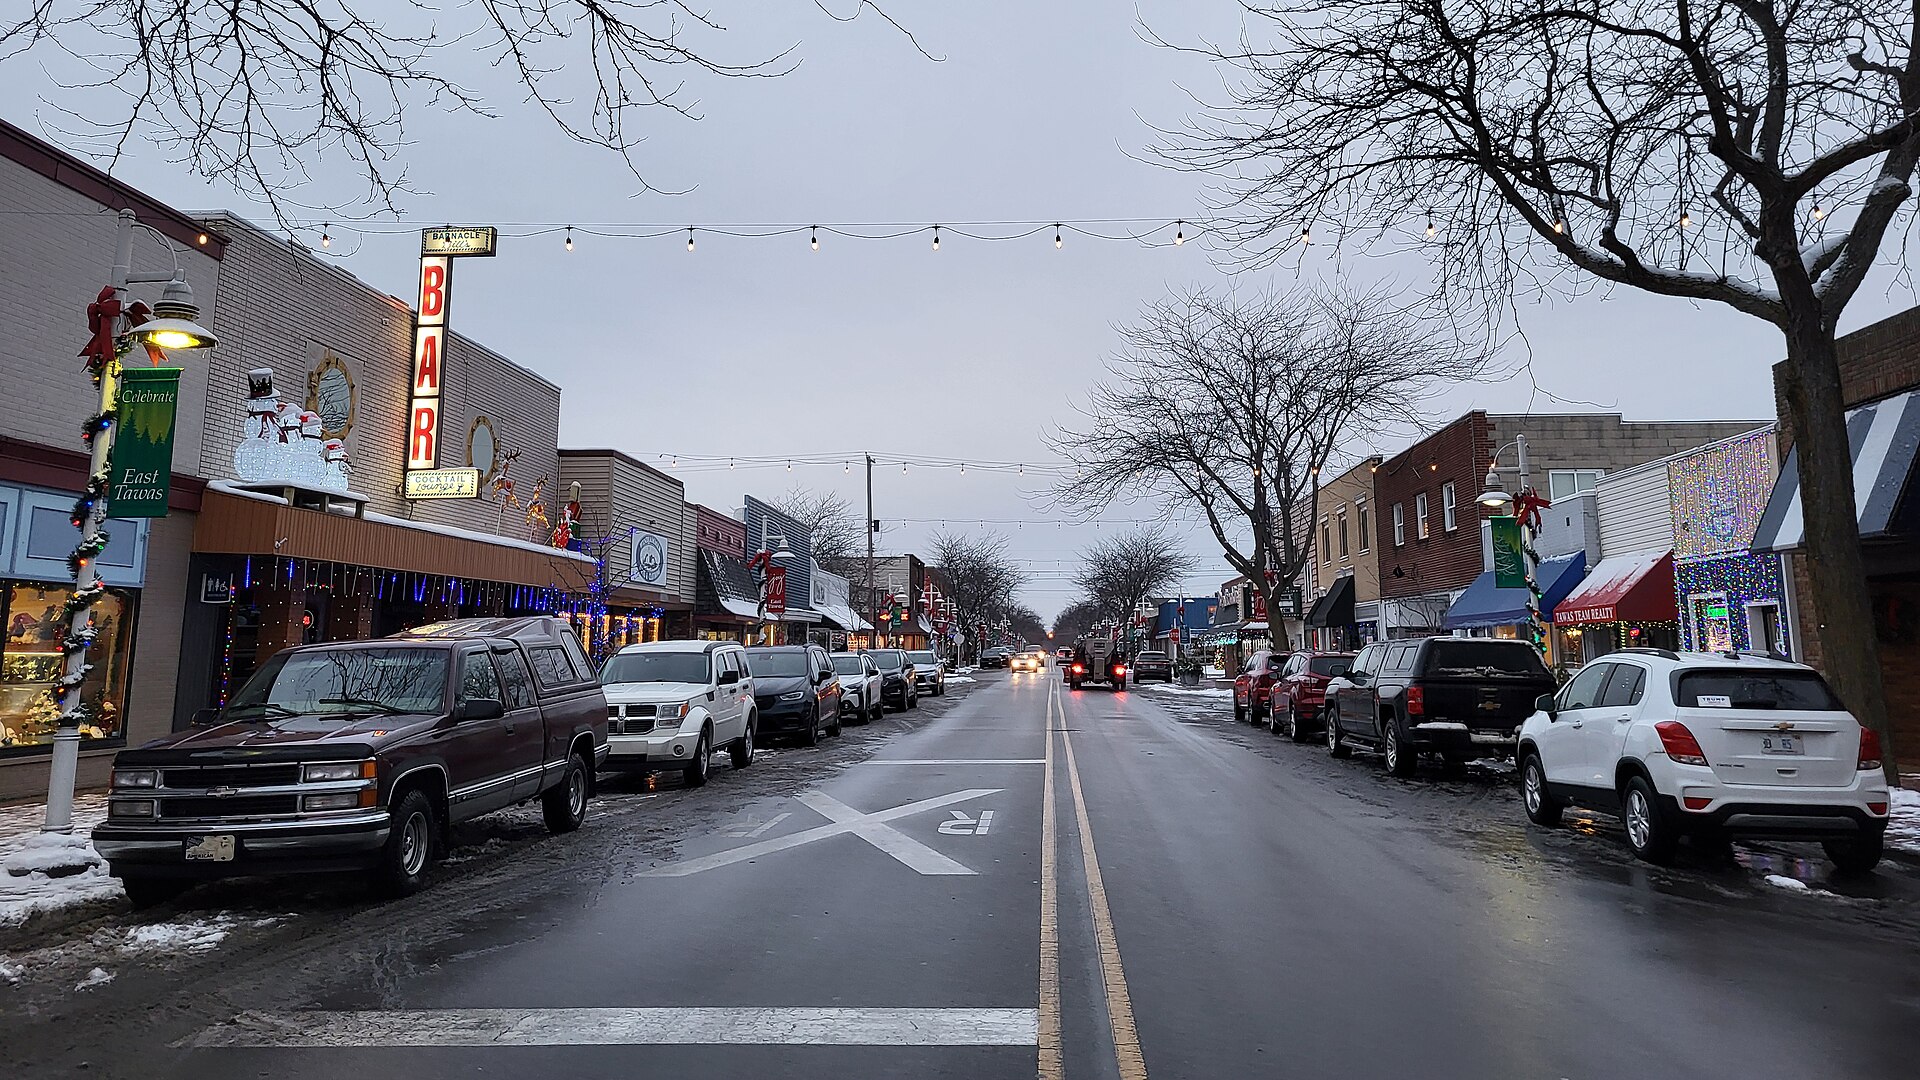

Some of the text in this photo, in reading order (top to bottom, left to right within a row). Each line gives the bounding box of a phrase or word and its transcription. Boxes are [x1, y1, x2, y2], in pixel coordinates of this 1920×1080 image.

[432, 232, 480, 240] BARNACLE
[442, 240, 470, 249] ill's
[411, 265, 444, 461] BAR
[122, 389, 175, 404] Celebrate
[122, 468, 159, 484] East
[114, 484, 163, 501] Tawas
[415, 483, 455, 493] Lounge
[768, 573, 786, 596] joy
[1556, 607, 1613, 623] TAWAS TEAM REALTY
